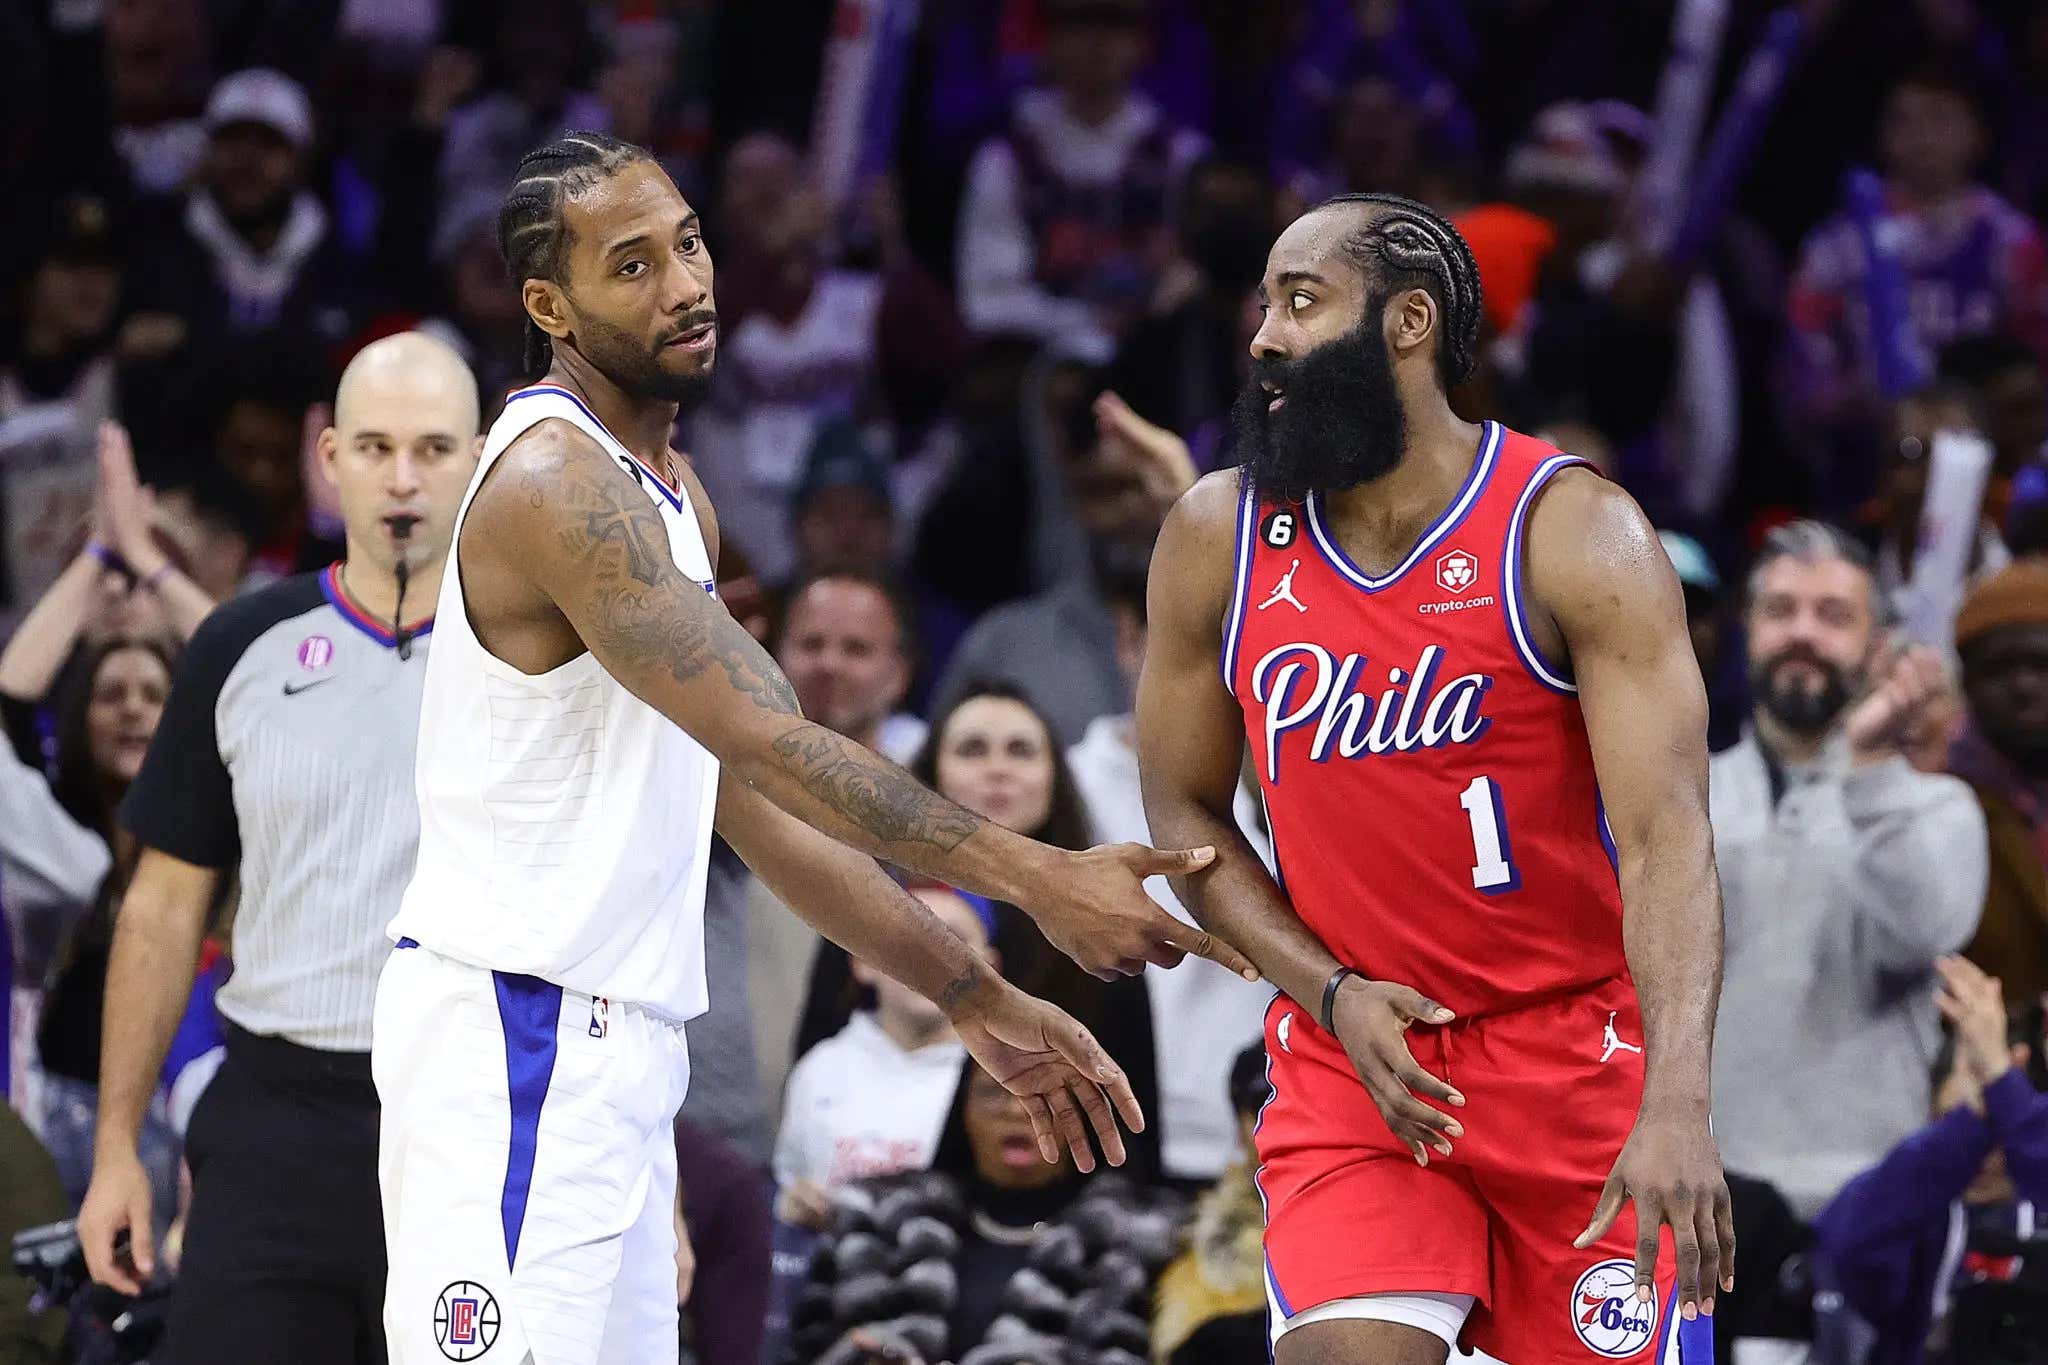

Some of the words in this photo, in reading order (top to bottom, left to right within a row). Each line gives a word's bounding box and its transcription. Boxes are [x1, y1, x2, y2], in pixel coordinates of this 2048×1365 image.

[1268, 514, 1293, 546] 6
[1418, 596, 1494, 614] crypto.com
[1252, 642, 1492, 785] Phila
[1460, 775, 1516, 892] 1
[1580, 1291, 1649, 1334] 76ers
